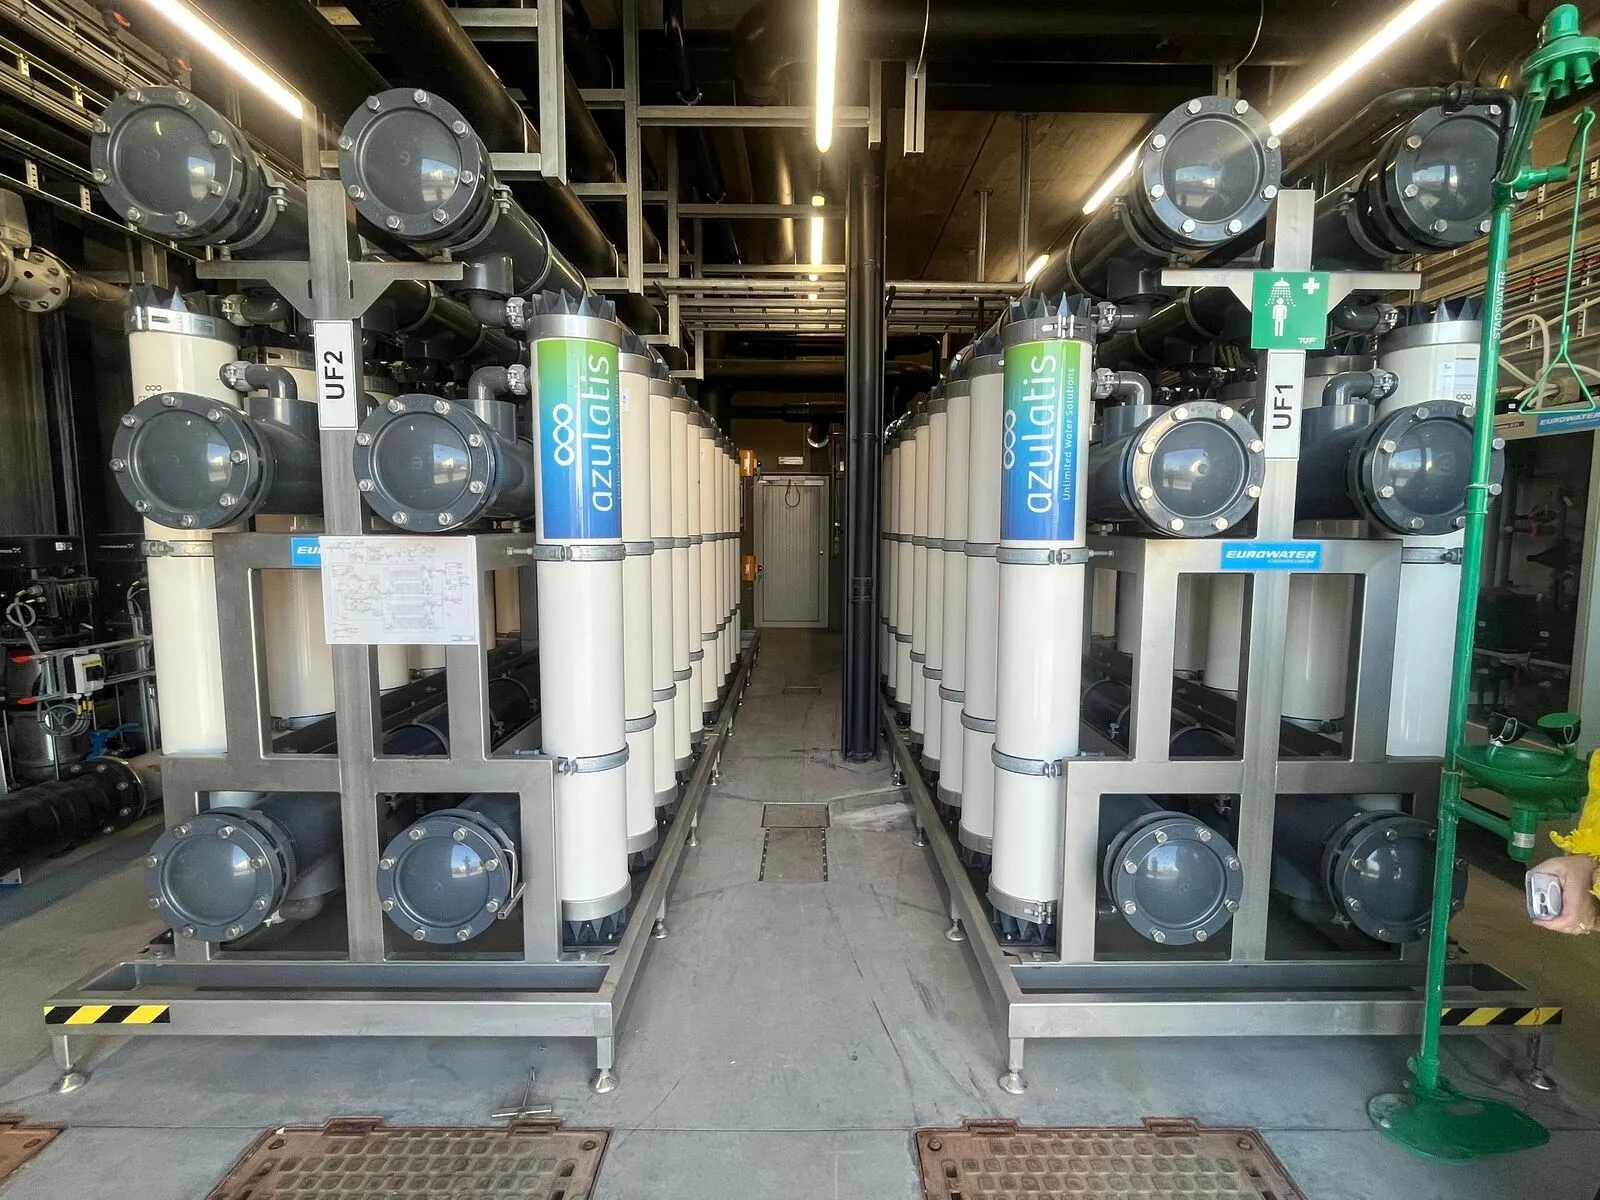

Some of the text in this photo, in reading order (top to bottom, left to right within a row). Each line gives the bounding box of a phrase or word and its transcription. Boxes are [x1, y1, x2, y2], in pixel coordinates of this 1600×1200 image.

[1492, 271, 1507, 340] STADSWATER
[323, 351, 345, 399] UF2
[1272, 384, 1294, 430] UF1
[581, 355, 613, 512] azulatis
[1021, 355, 1057, 513] azulatis
[1062, 367, 1075, 501] Unlimited Water Solutions
[1225, 550, 1317, 559] EUROWATER
